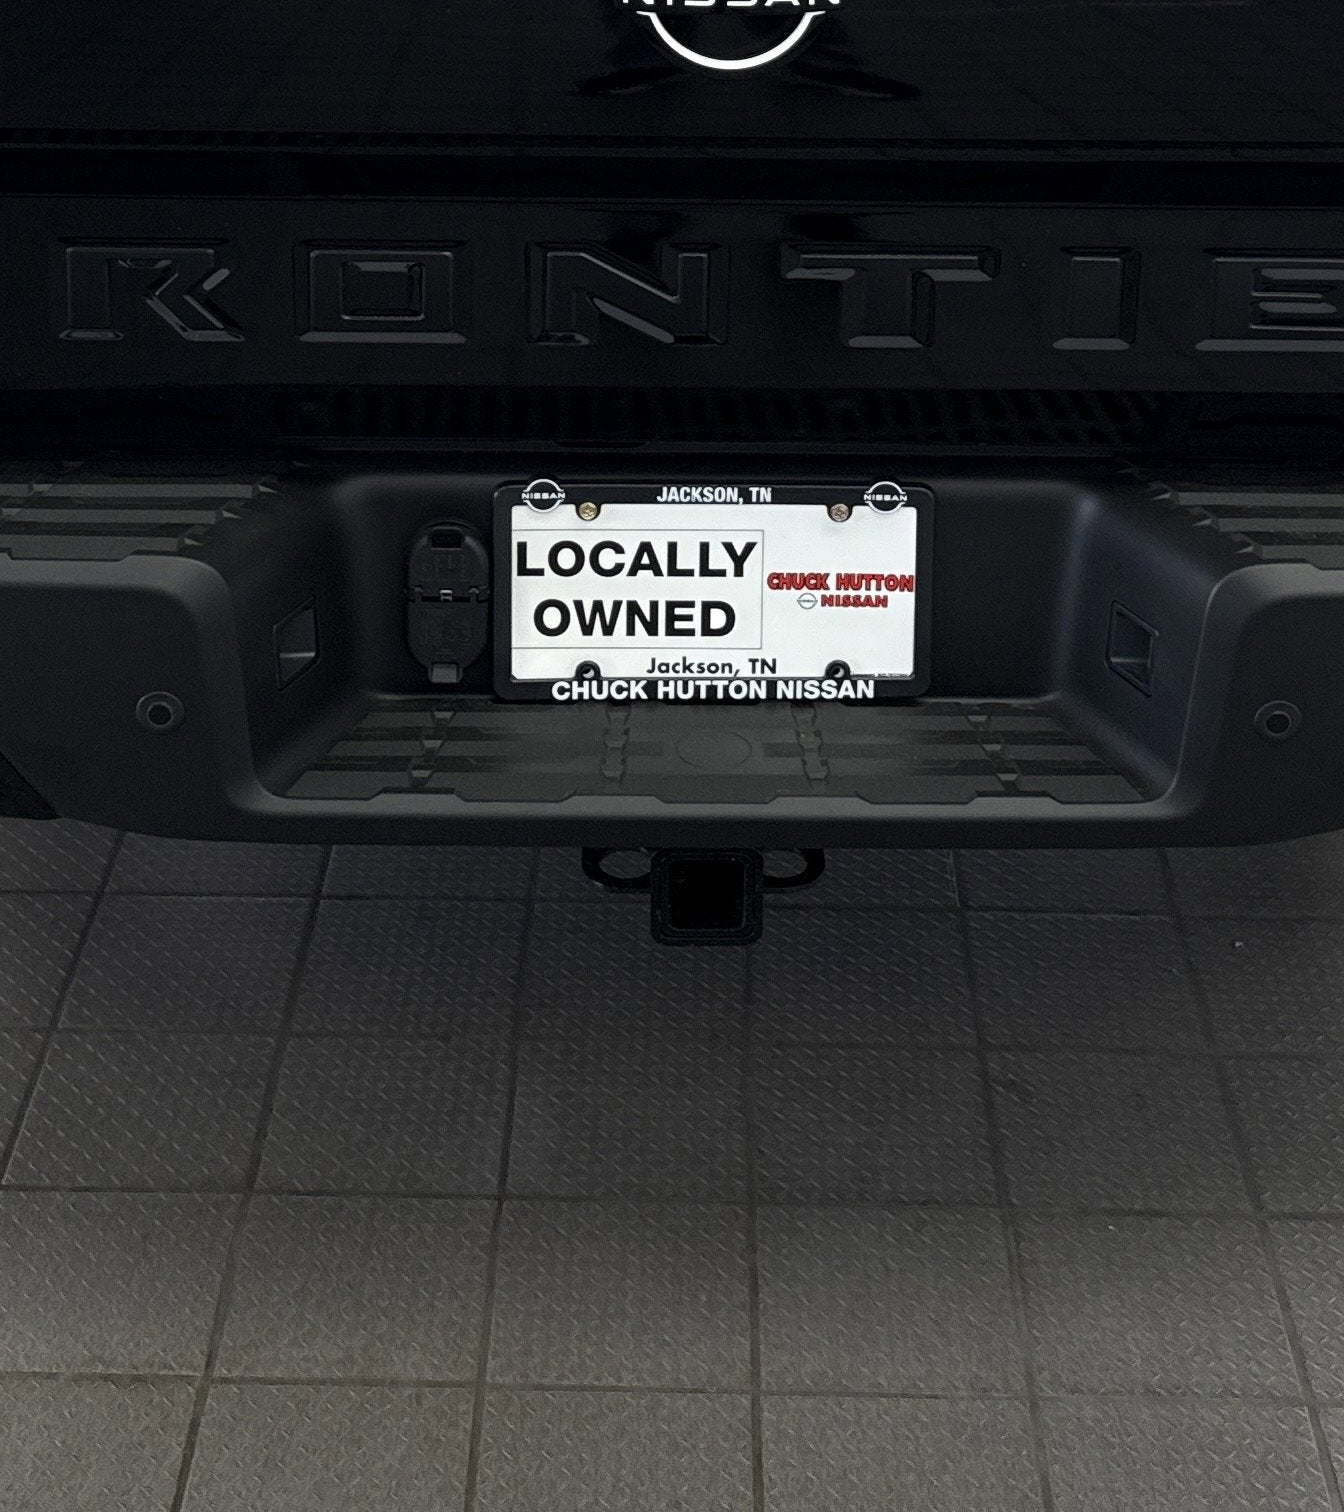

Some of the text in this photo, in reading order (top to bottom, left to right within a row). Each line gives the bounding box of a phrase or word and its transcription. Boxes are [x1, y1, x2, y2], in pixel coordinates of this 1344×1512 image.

[521, 492, 566, 500] NISSAN
[657, 487, 772, 505] JACKSON, TN
[863, 493, 908, 502] NISSAN
[516, 540, 758, 578] LOCALLY
[767, 572, 914, 592] CHUCK HUTTON
[821, 594, 888, 608] NISSAN
[533, 599, 736, 637] OWNED
[646, 657, 777, 677] Jackson, TN
[552, 680, 875, 700] CHUCK HUTTON NISSAN
